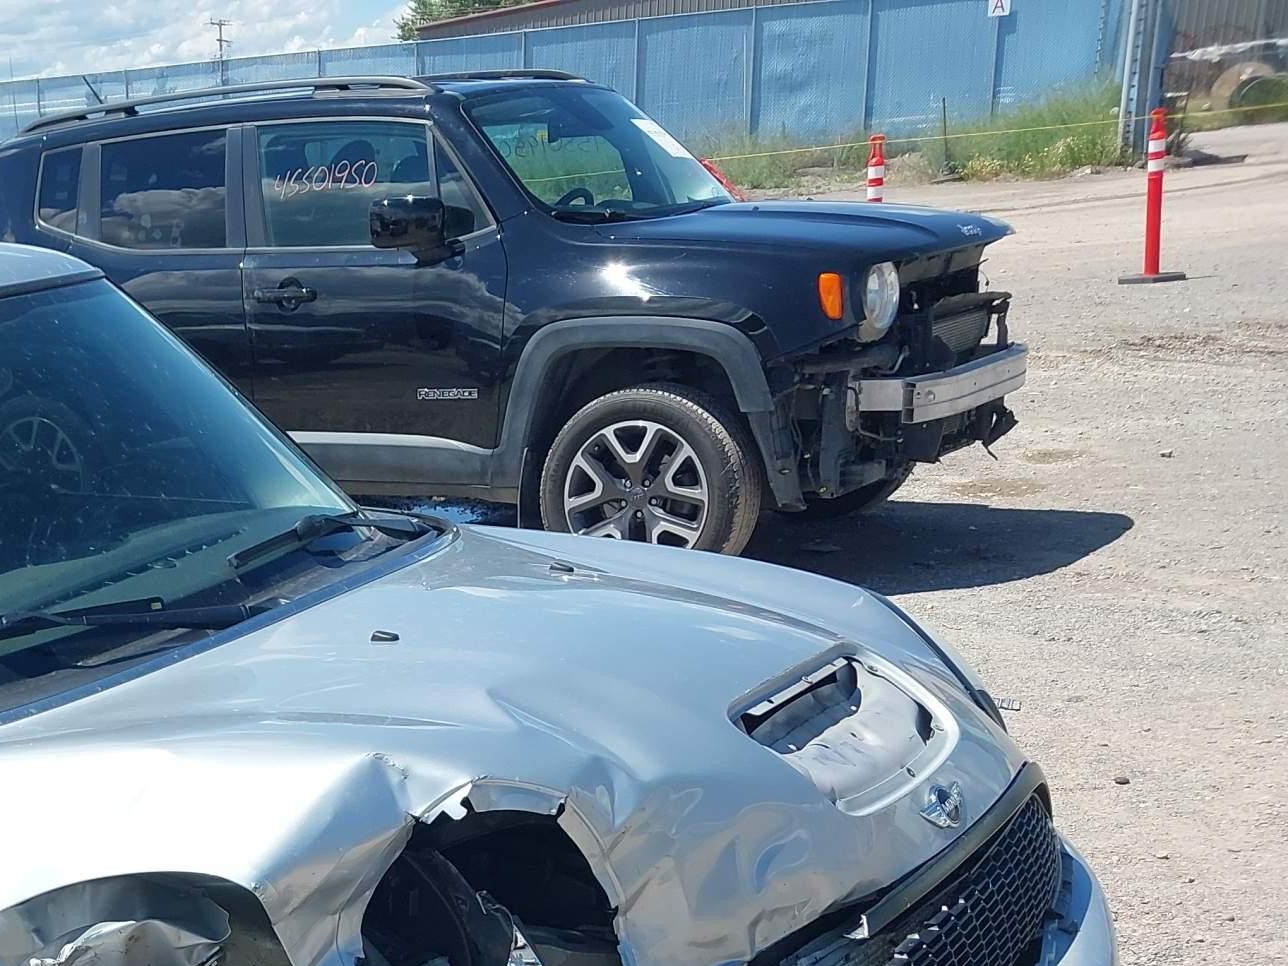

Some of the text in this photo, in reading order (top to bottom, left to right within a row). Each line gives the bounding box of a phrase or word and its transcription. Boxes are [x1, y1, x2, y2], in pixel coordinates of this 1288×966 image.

[992, 0, 1005, 14] A
[274, 160, 378, 200] 45501950
[417, 388, 478, 400] RENEGADE
